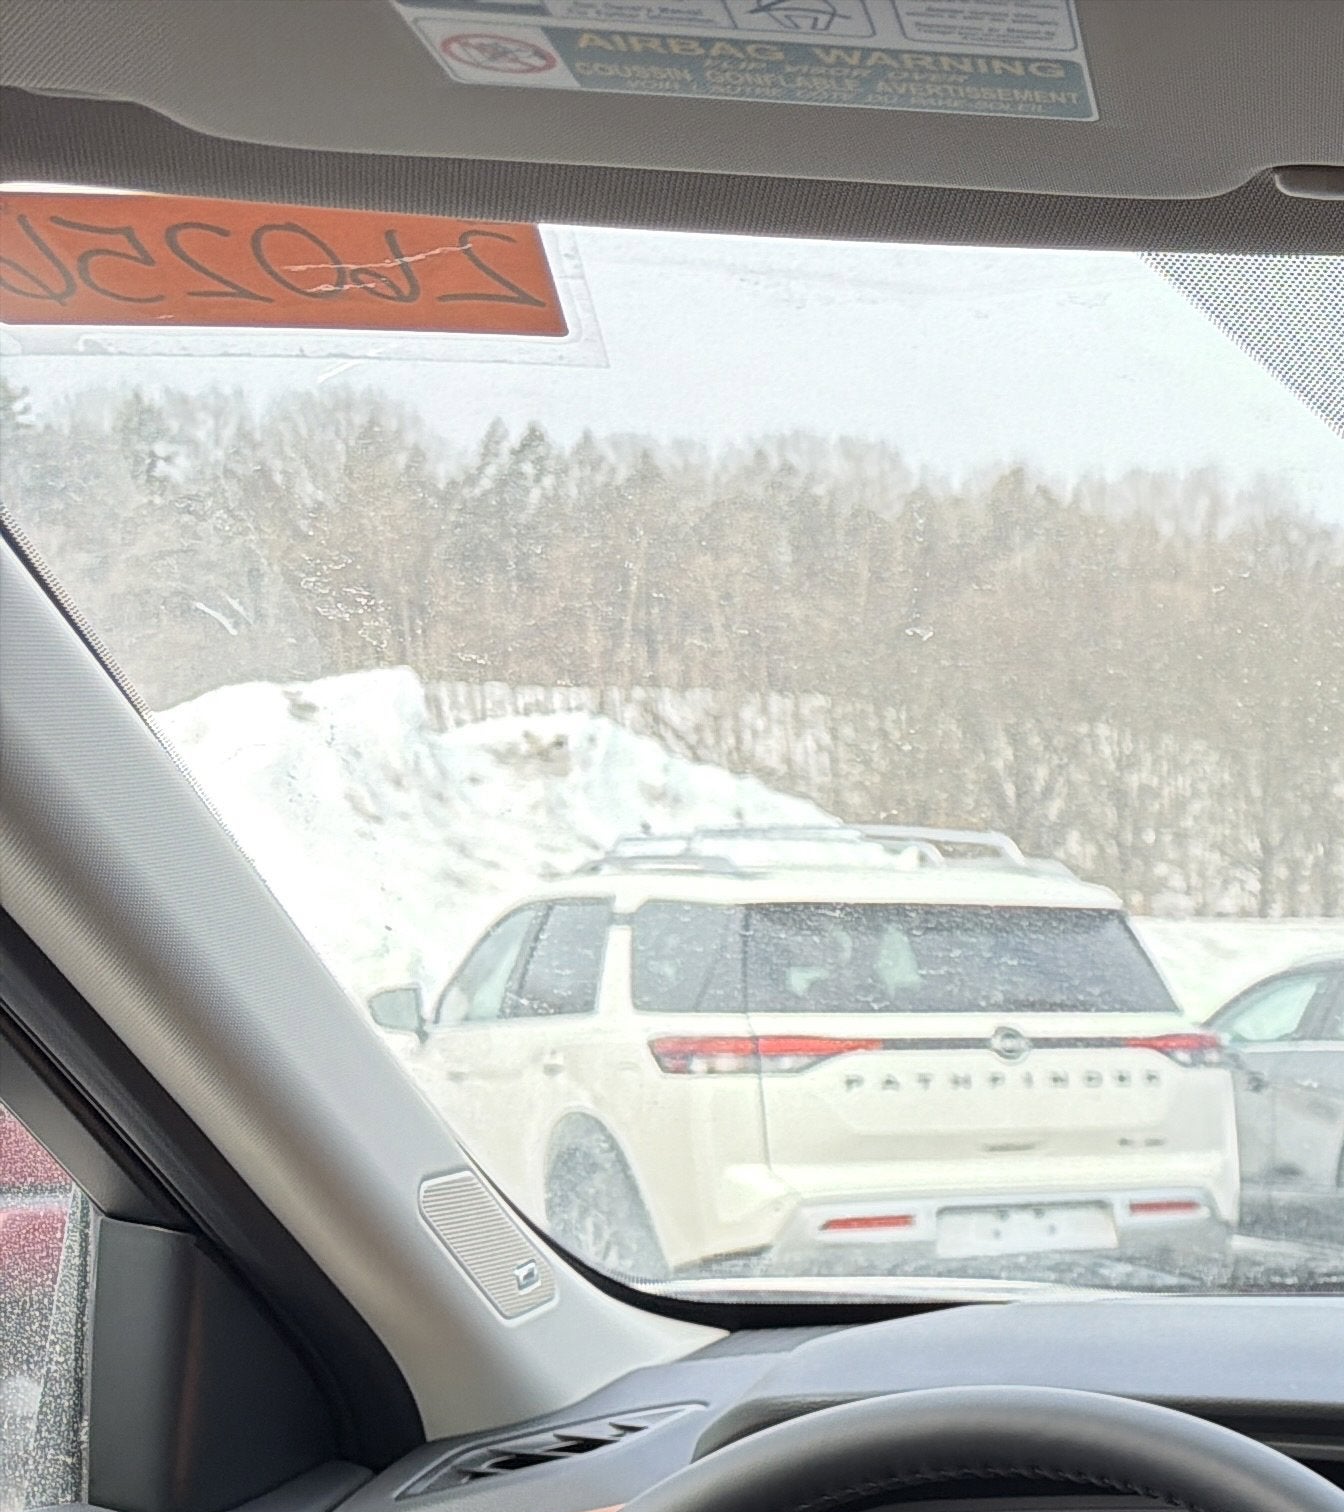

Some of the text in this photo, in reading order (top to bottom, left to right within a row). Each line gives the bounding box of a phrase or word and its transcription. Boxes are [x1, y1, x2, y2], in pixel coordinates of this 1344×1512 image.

[578, 32, 784, 61] AIRBAG
[815, 46, 1066, 78] WARNING
[575, 61, 692, 83] COUSSIN
[877, 80, 1079, 105] AVERTISSEMENT
[845, 1070, 1158, 1092] PATHFINDER
